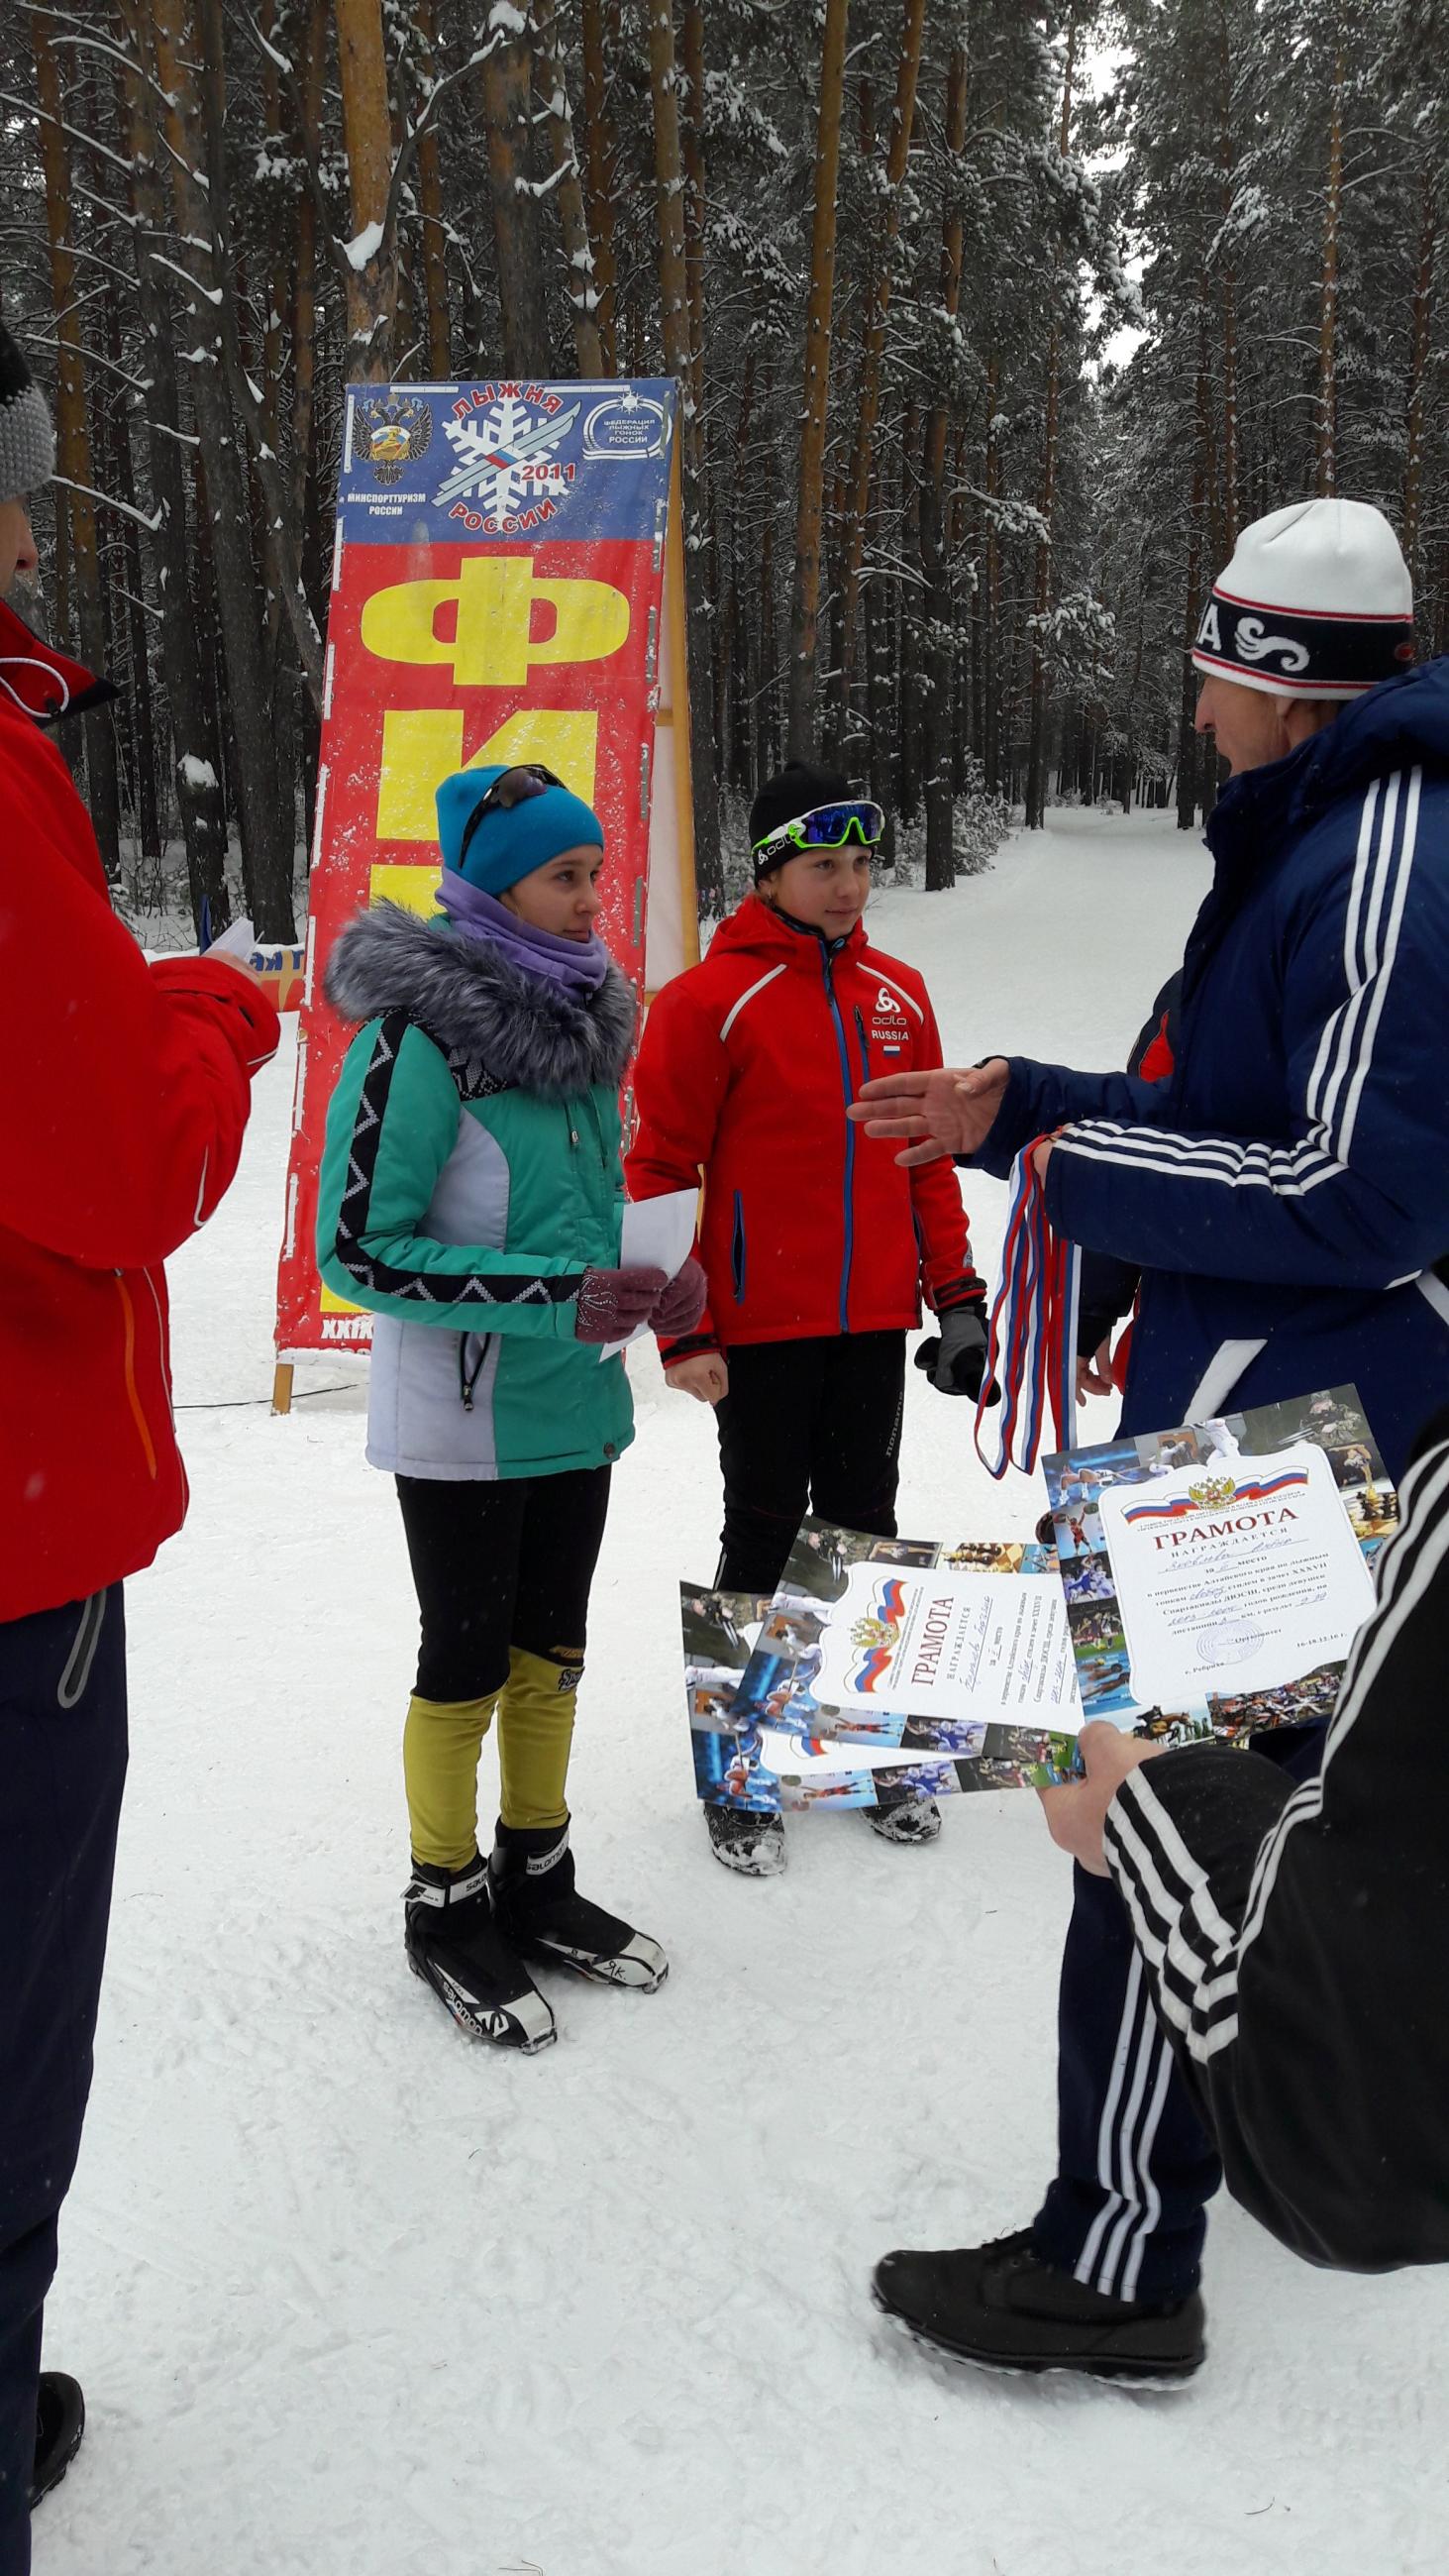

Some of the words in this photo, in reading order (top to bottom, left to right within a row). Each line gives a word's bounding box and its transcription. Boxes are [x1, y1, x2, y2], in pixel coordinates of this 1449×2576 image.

[451, 380, 564, 419] ЛЫЖНЯ
[521, 463, 575, 483] 2011
[347, 492, 427, 503] МИНСПОРТТУРИЗМ
[368, 505, 403, 515] РОССИИ
[449, 497, 558, 534] РОССИИ
[872, 1015, 907, 1026] odlo
[871, 1028, 910, 1041] RUSSIA
[1155, 1508, 1296, 1549] ГРАМОТА
[1172, 1528, 1287, 1557] НАГРАЖДАЕТСЯ
[1238, 1556, 1267, 1565] место
[911, 1598, 953, 1684] ГРАМОТА
[947, 1607, 970, 1679] НАГРАЖДАЕТСЯ
